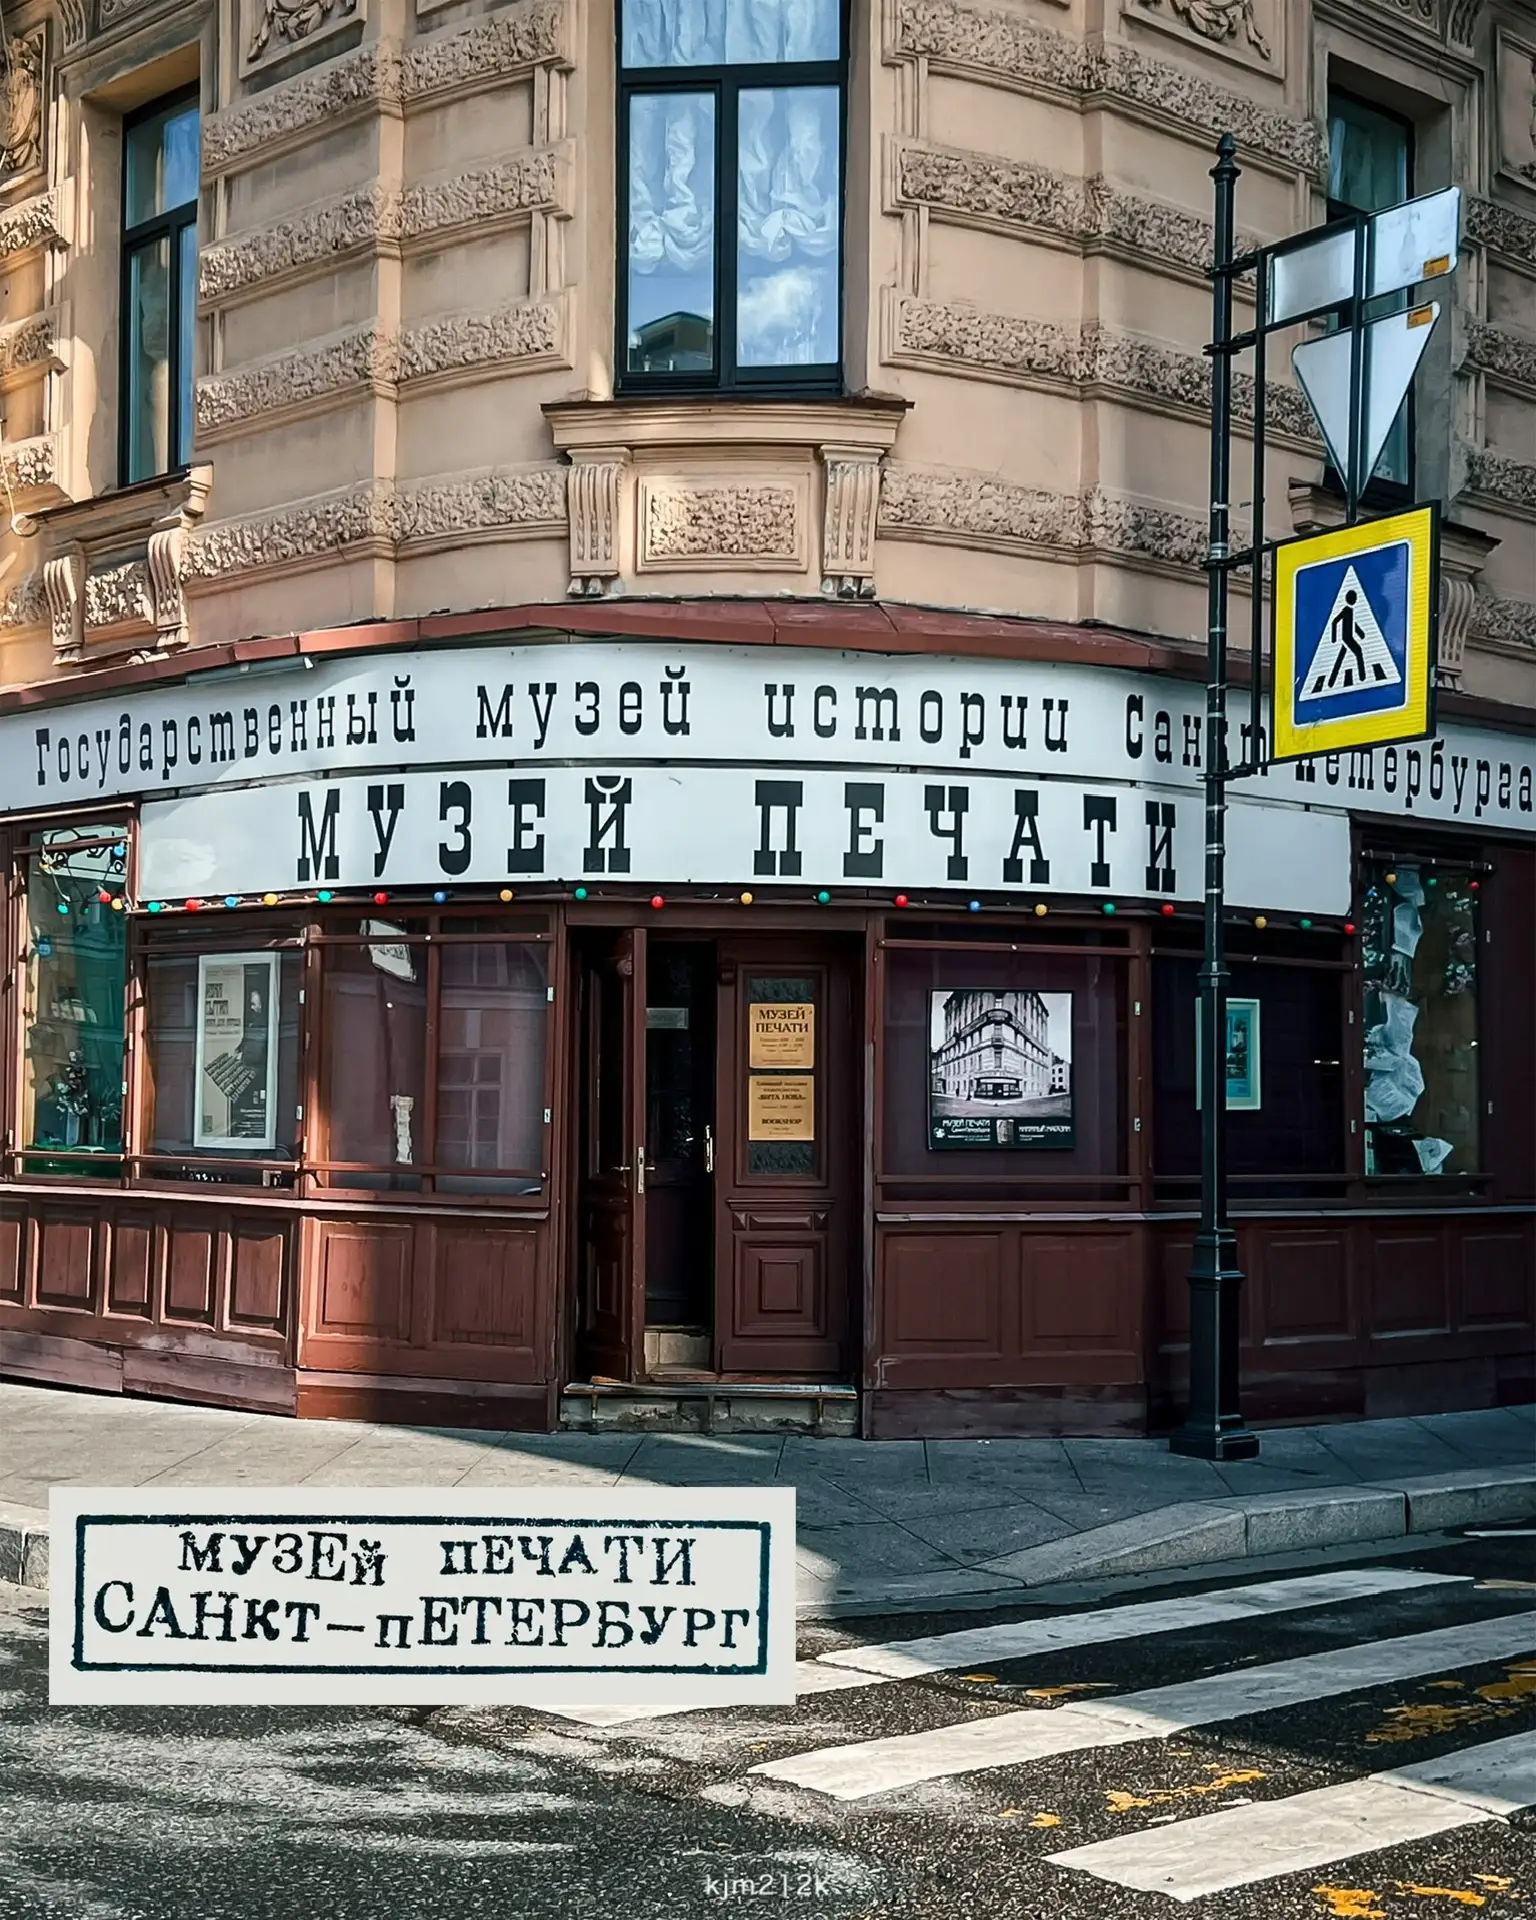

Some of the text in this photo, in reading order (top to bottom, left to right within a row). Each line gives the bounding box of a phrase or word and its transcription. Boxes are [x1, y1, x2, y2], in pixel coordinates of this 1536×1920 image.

[36, 675, 415, 789] Государственный
[477, 665, 691, 750] музей
[765, 683, 1069, 759] истории
[297, 775, 1177, 894] МУЗЕЙ ПЕЧАТИ
[756, 1022, 808, 1033] ПЕЧАТИ
[759, 1006, 805, 1020] МУЗЕЙ
